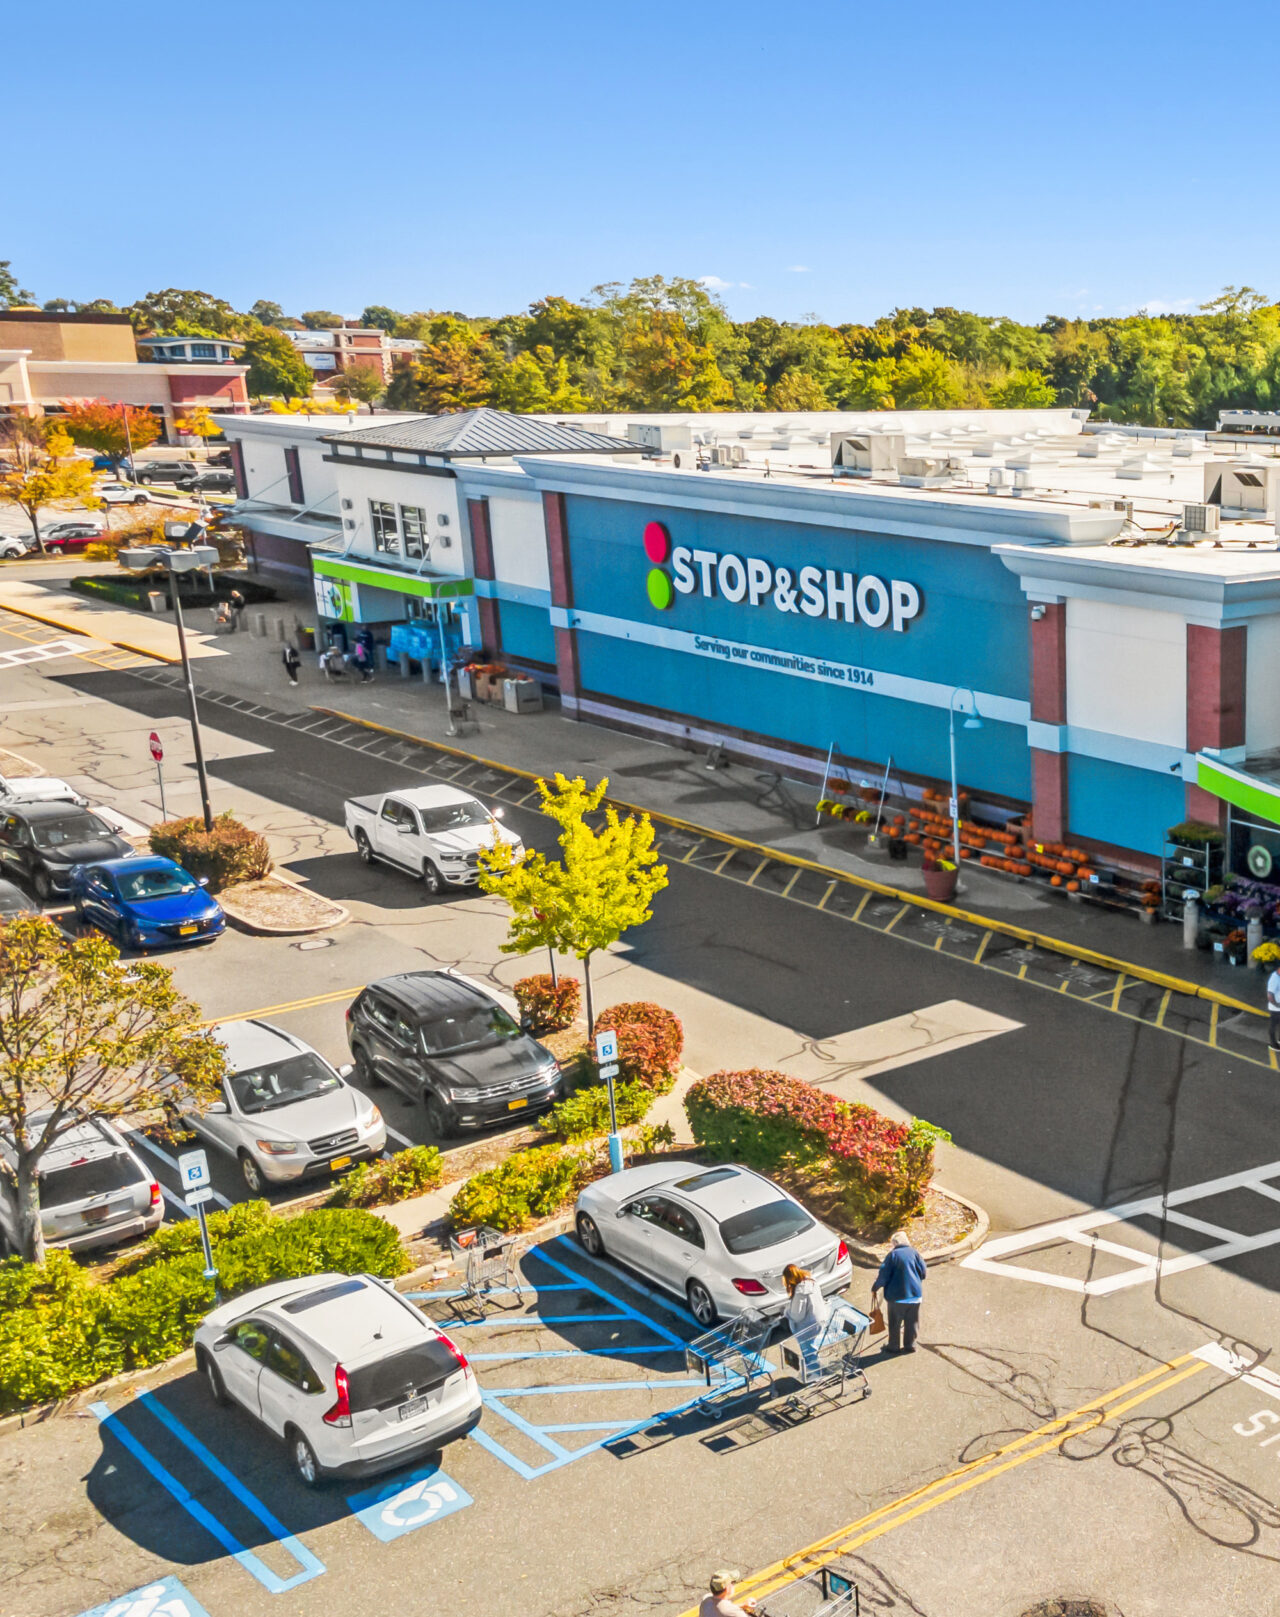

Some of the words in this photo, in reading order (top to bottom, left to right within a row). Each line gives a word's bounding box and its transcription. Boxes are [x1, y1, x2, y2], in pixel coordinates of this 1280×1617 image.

[672, 546, 920, 632] STOP&SHOP
[694, 635, 731, 659] Serving
[732, 646, 749, 659] our
[750, 650, 816, 674] communities
[817, 662, 845, 680] since
[847, 668, 874, 686] 1914
